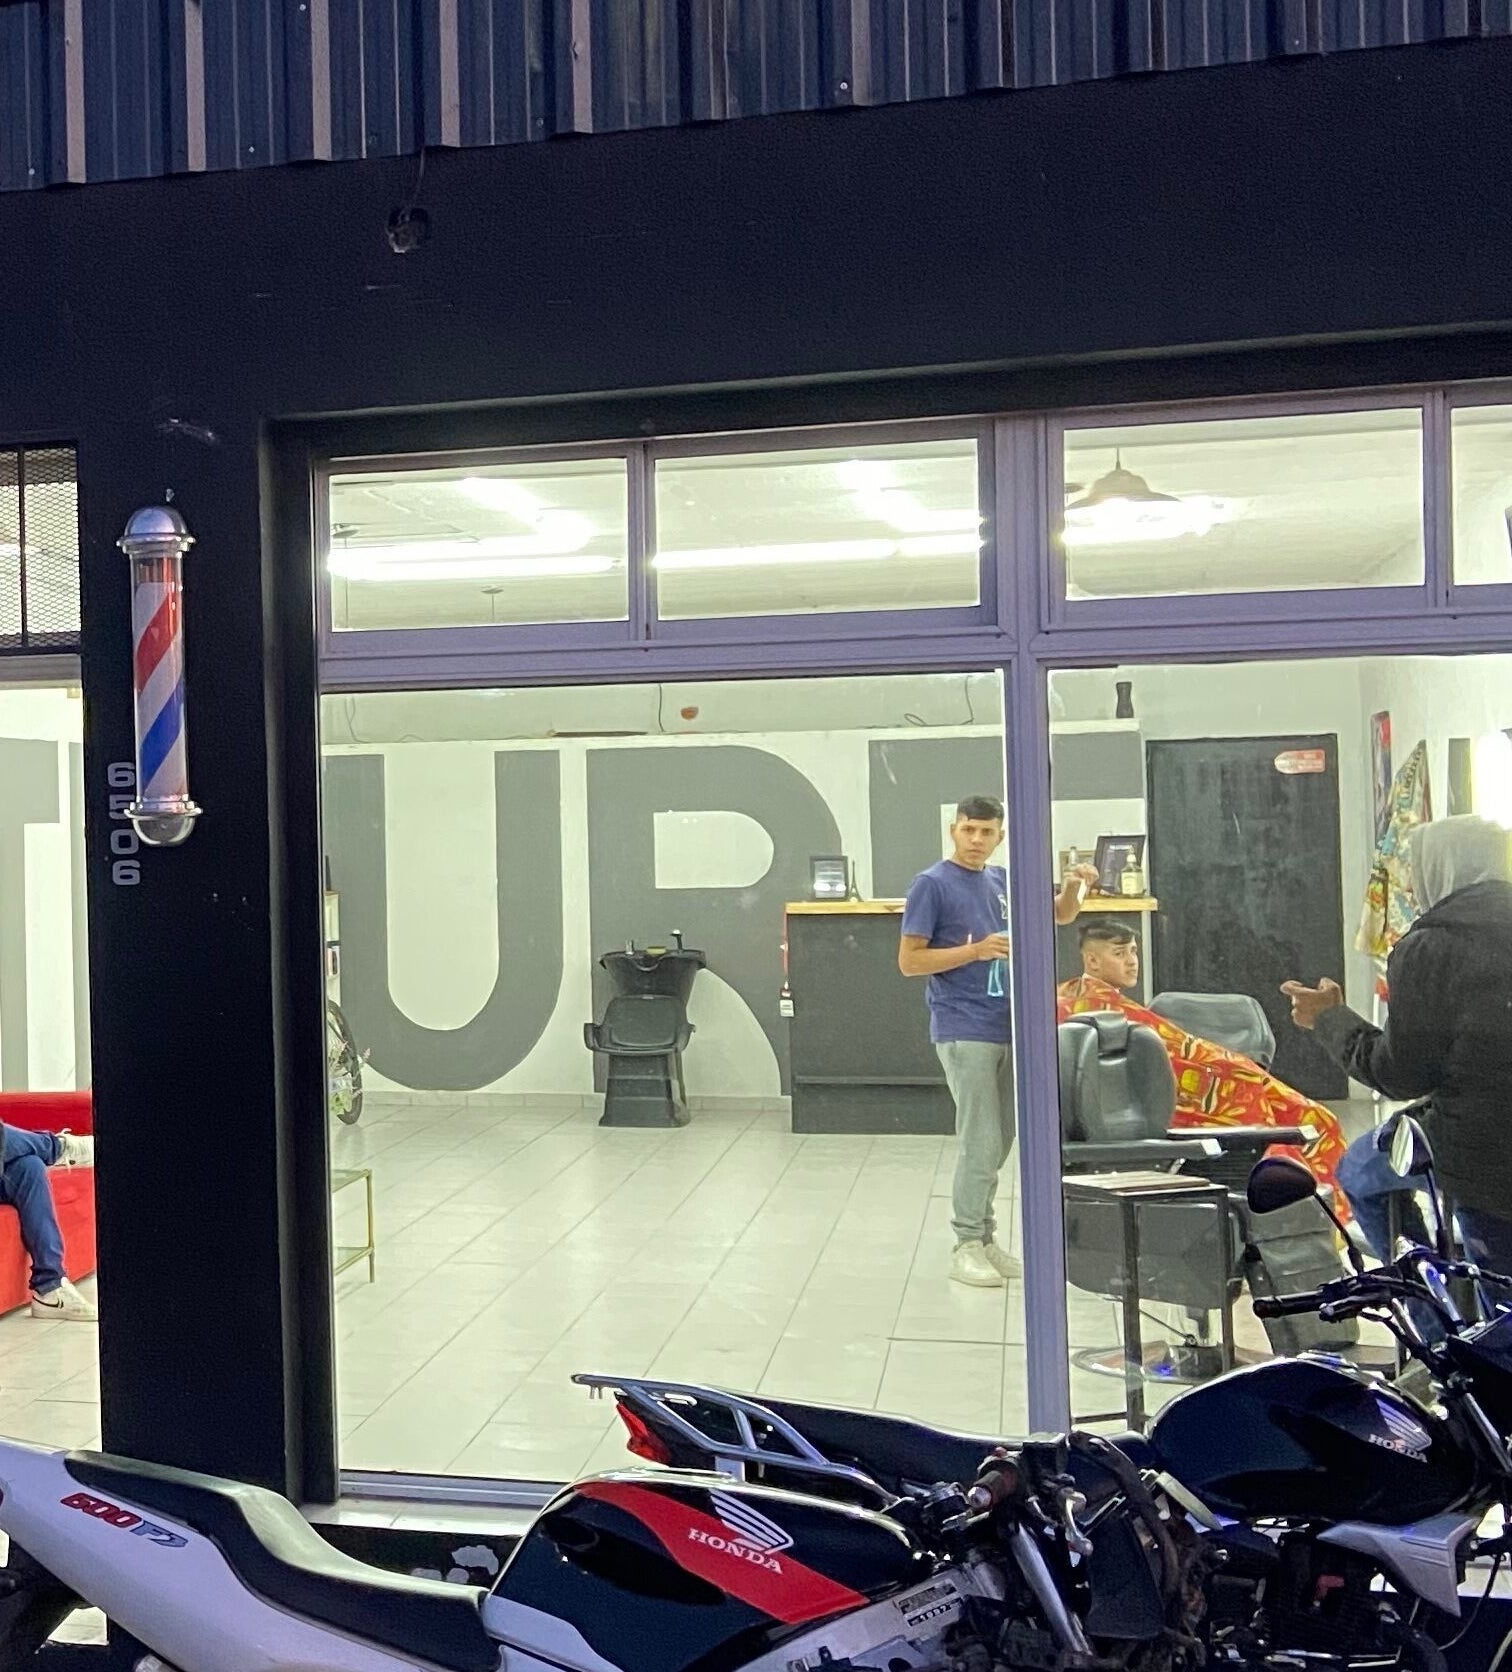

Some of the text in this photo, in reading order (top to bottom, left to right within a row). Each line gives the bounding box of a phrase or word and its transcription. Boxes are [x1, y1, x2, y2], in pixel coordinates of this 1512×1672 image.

[107, 761, 141, 886] 6506
[1369, 1433, 1428, 1463] HONDA
[688, 1527, 783, 1575] HONDA
